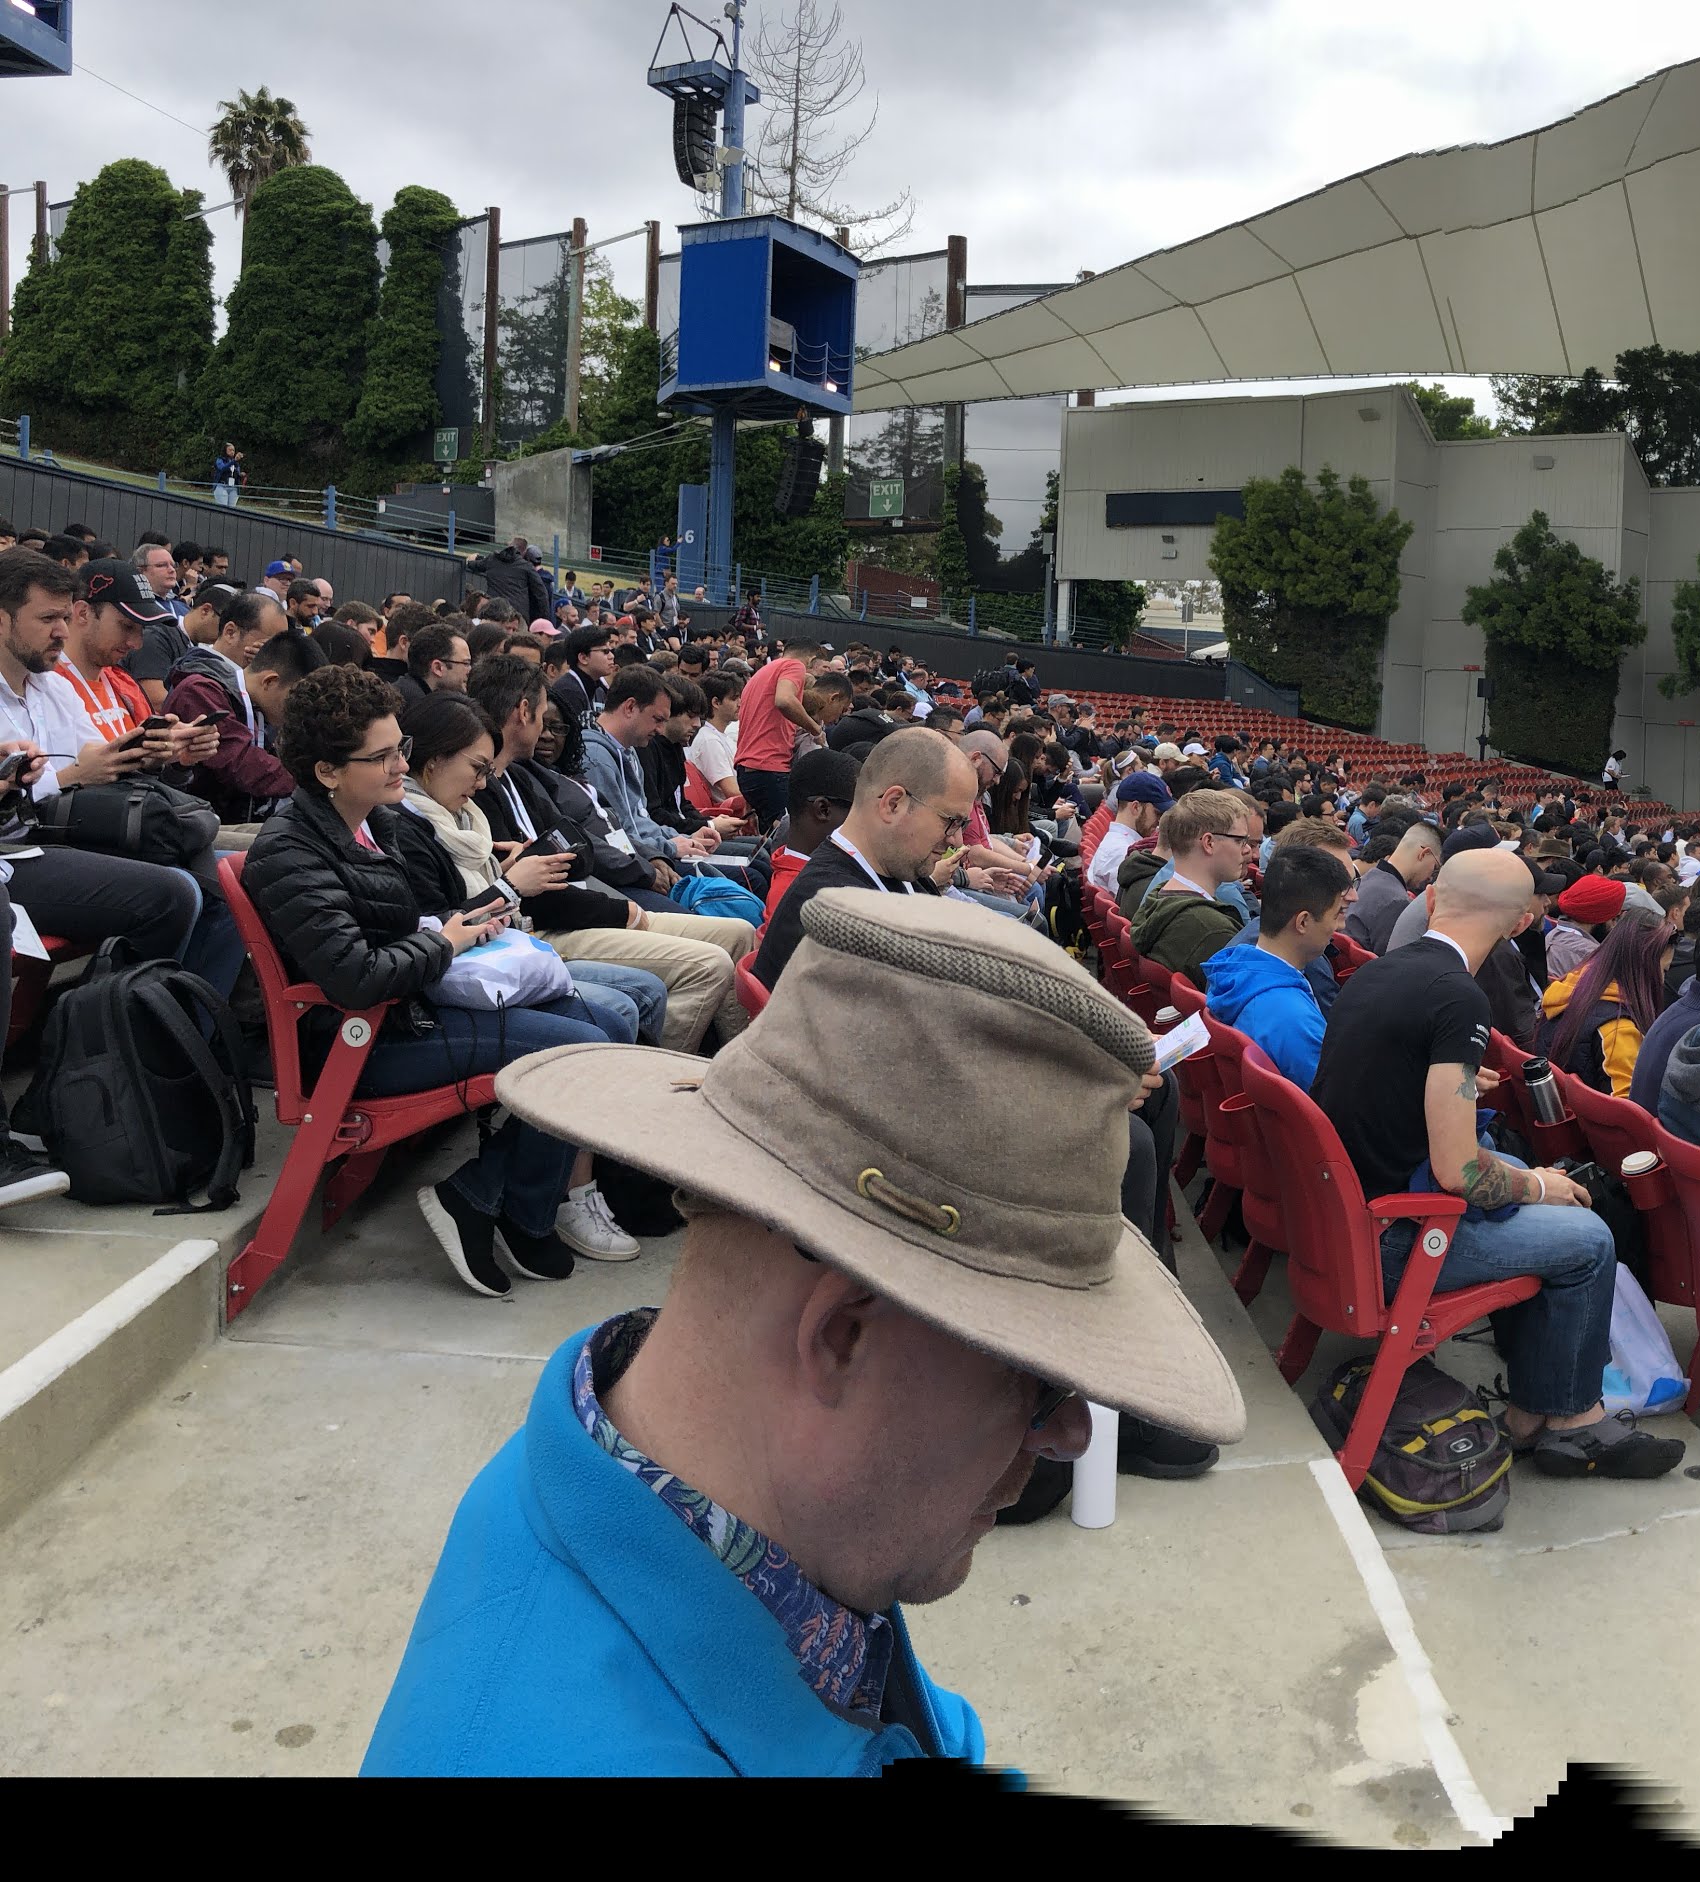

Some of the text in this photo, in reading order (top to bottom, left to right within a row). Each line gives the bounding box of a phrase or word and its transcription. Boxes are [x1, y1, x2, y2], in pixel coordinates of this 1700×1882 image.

[437, 432, 456, 442] EXIT
[873, 484, 901, 496] EXIT
[685, 529, 694, 544] 6
[350, 1025, 363, 1041] Q
[1428, 1236, 1441, 1249] O
